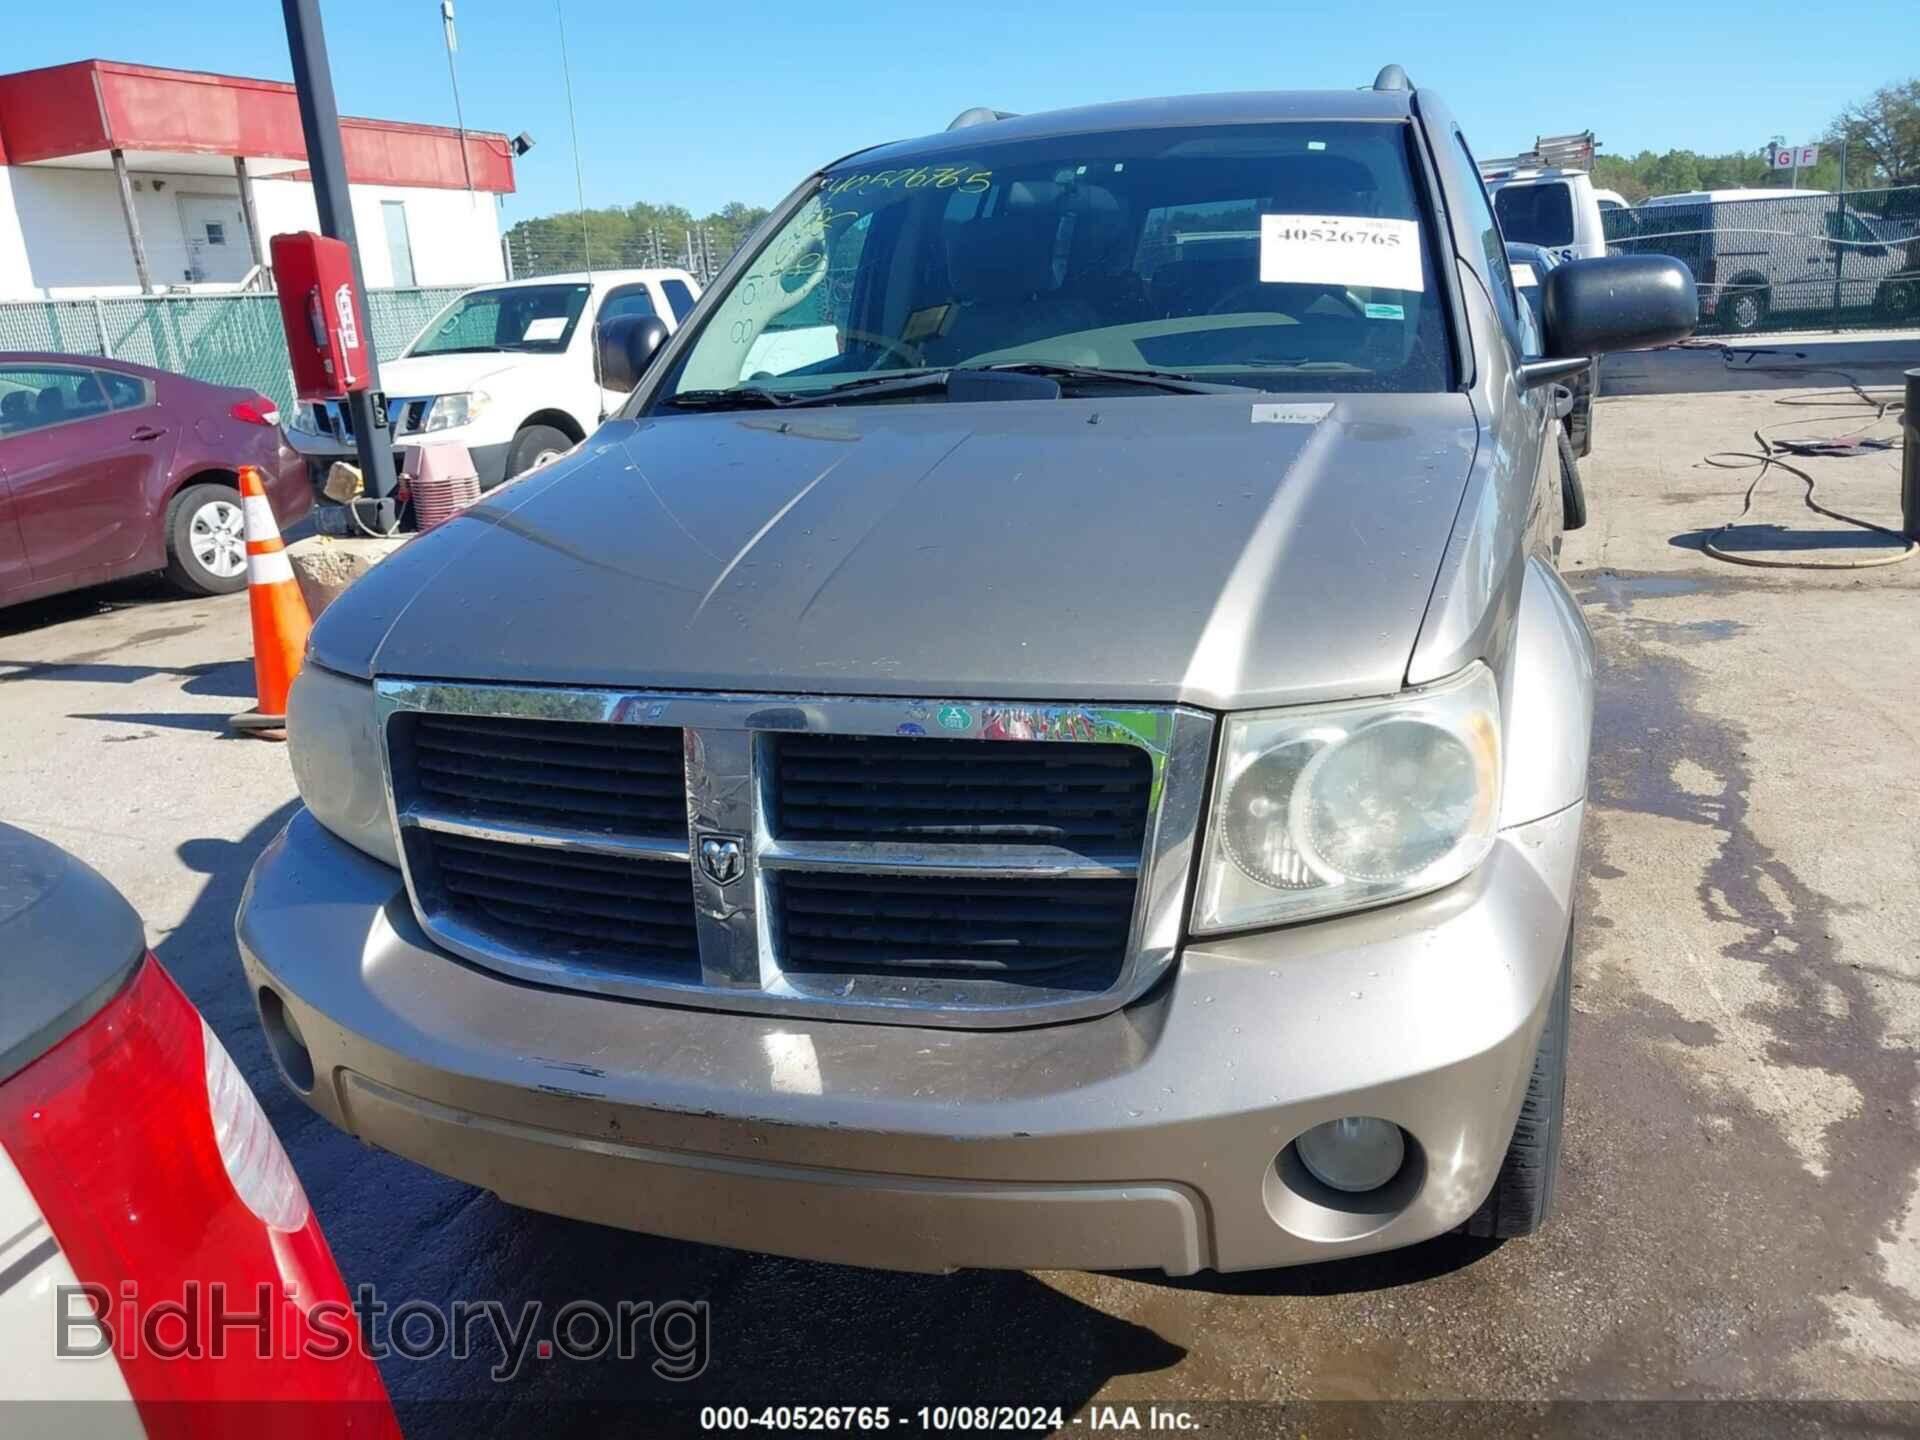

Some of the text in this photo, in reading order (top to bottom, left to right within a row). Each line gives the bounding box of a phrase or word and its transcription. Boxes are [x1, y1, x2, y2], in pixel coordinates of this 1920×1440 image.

[1778, 151, 1791, 166] G
[1802, 149, 1813, 164] F
[1278, 227, 1401, 247] 40526765
[341, 300, 357, 343] FIRE
